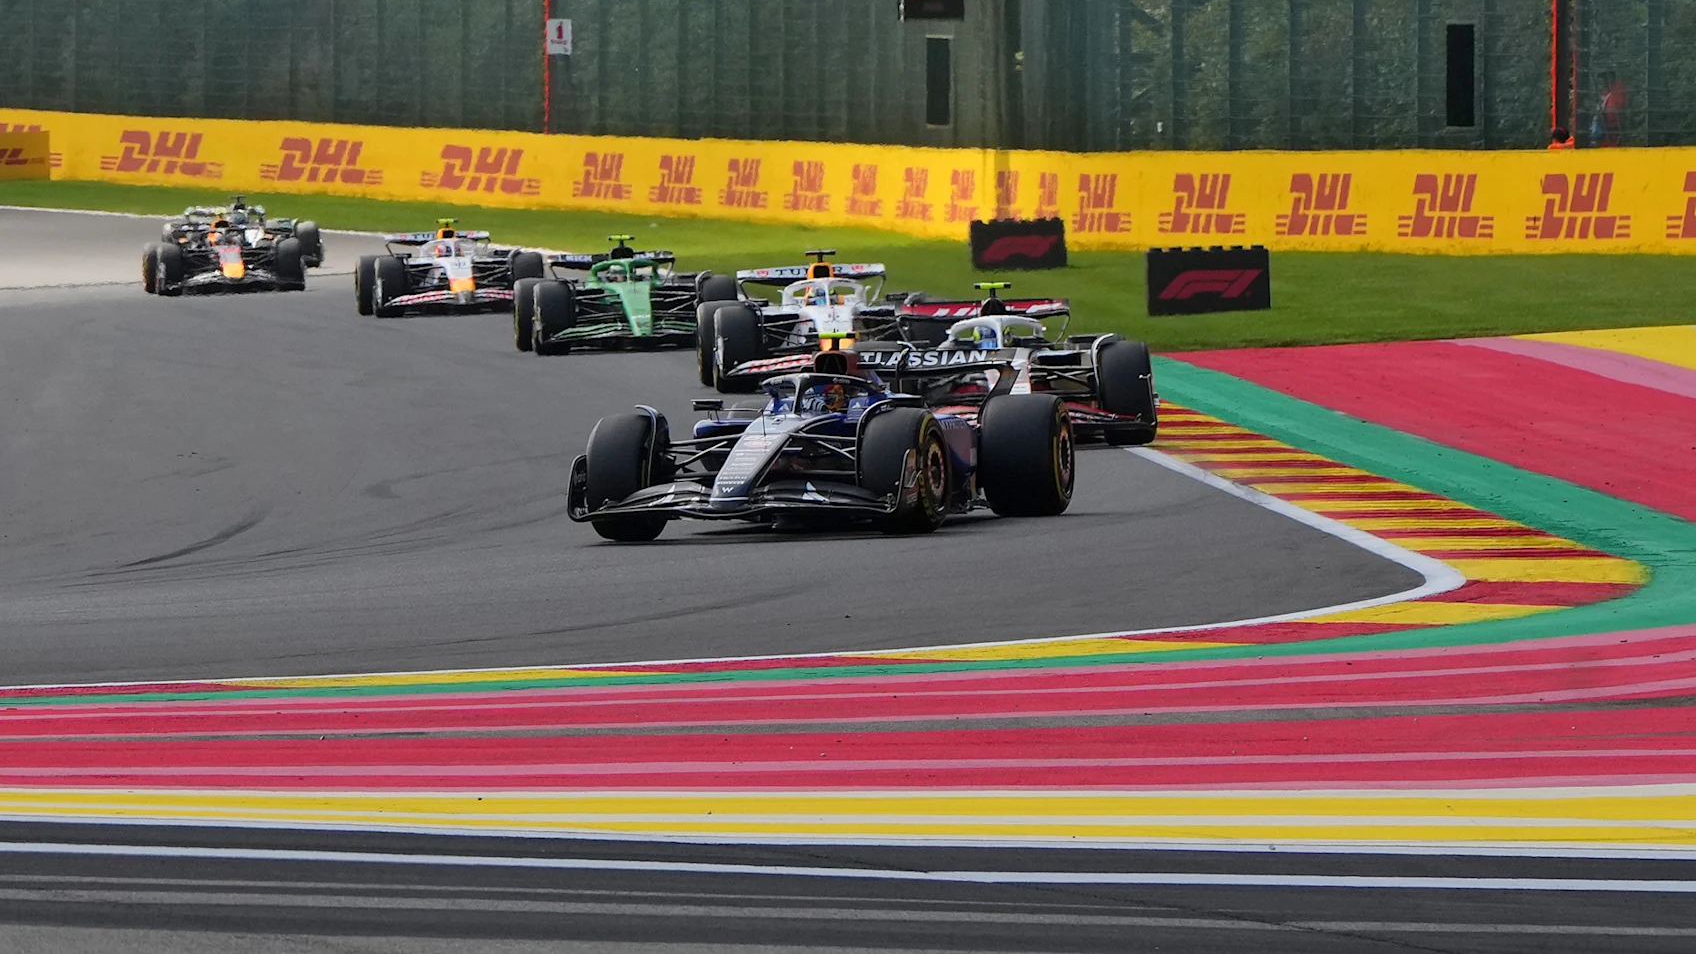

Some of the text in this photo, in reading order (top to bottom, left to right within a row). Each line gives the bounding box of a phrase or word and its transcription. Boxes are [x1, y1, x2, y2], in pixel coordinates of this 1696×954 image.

[116, 130, 205, 176] DHL
[277, 137, 365, 184] DHL
[438, 145, 525, 194] DHL
[580, 152, 623, 200] DHL
[658, 155, 696, 205] DHL
[1077, 173, 1119, 233] DHL
[1170, 173, 1235, 235] DHL
[1288, 173, 1356, 236] DHL
[1411, 174, 1480, 239] DHL
[1539, 172, 1617, 240] DHL
[775, 266, 843, 277] TUR
[1159, 270, 1263, 299] F1
[860, 350, 988, 366] TLASSIAN
